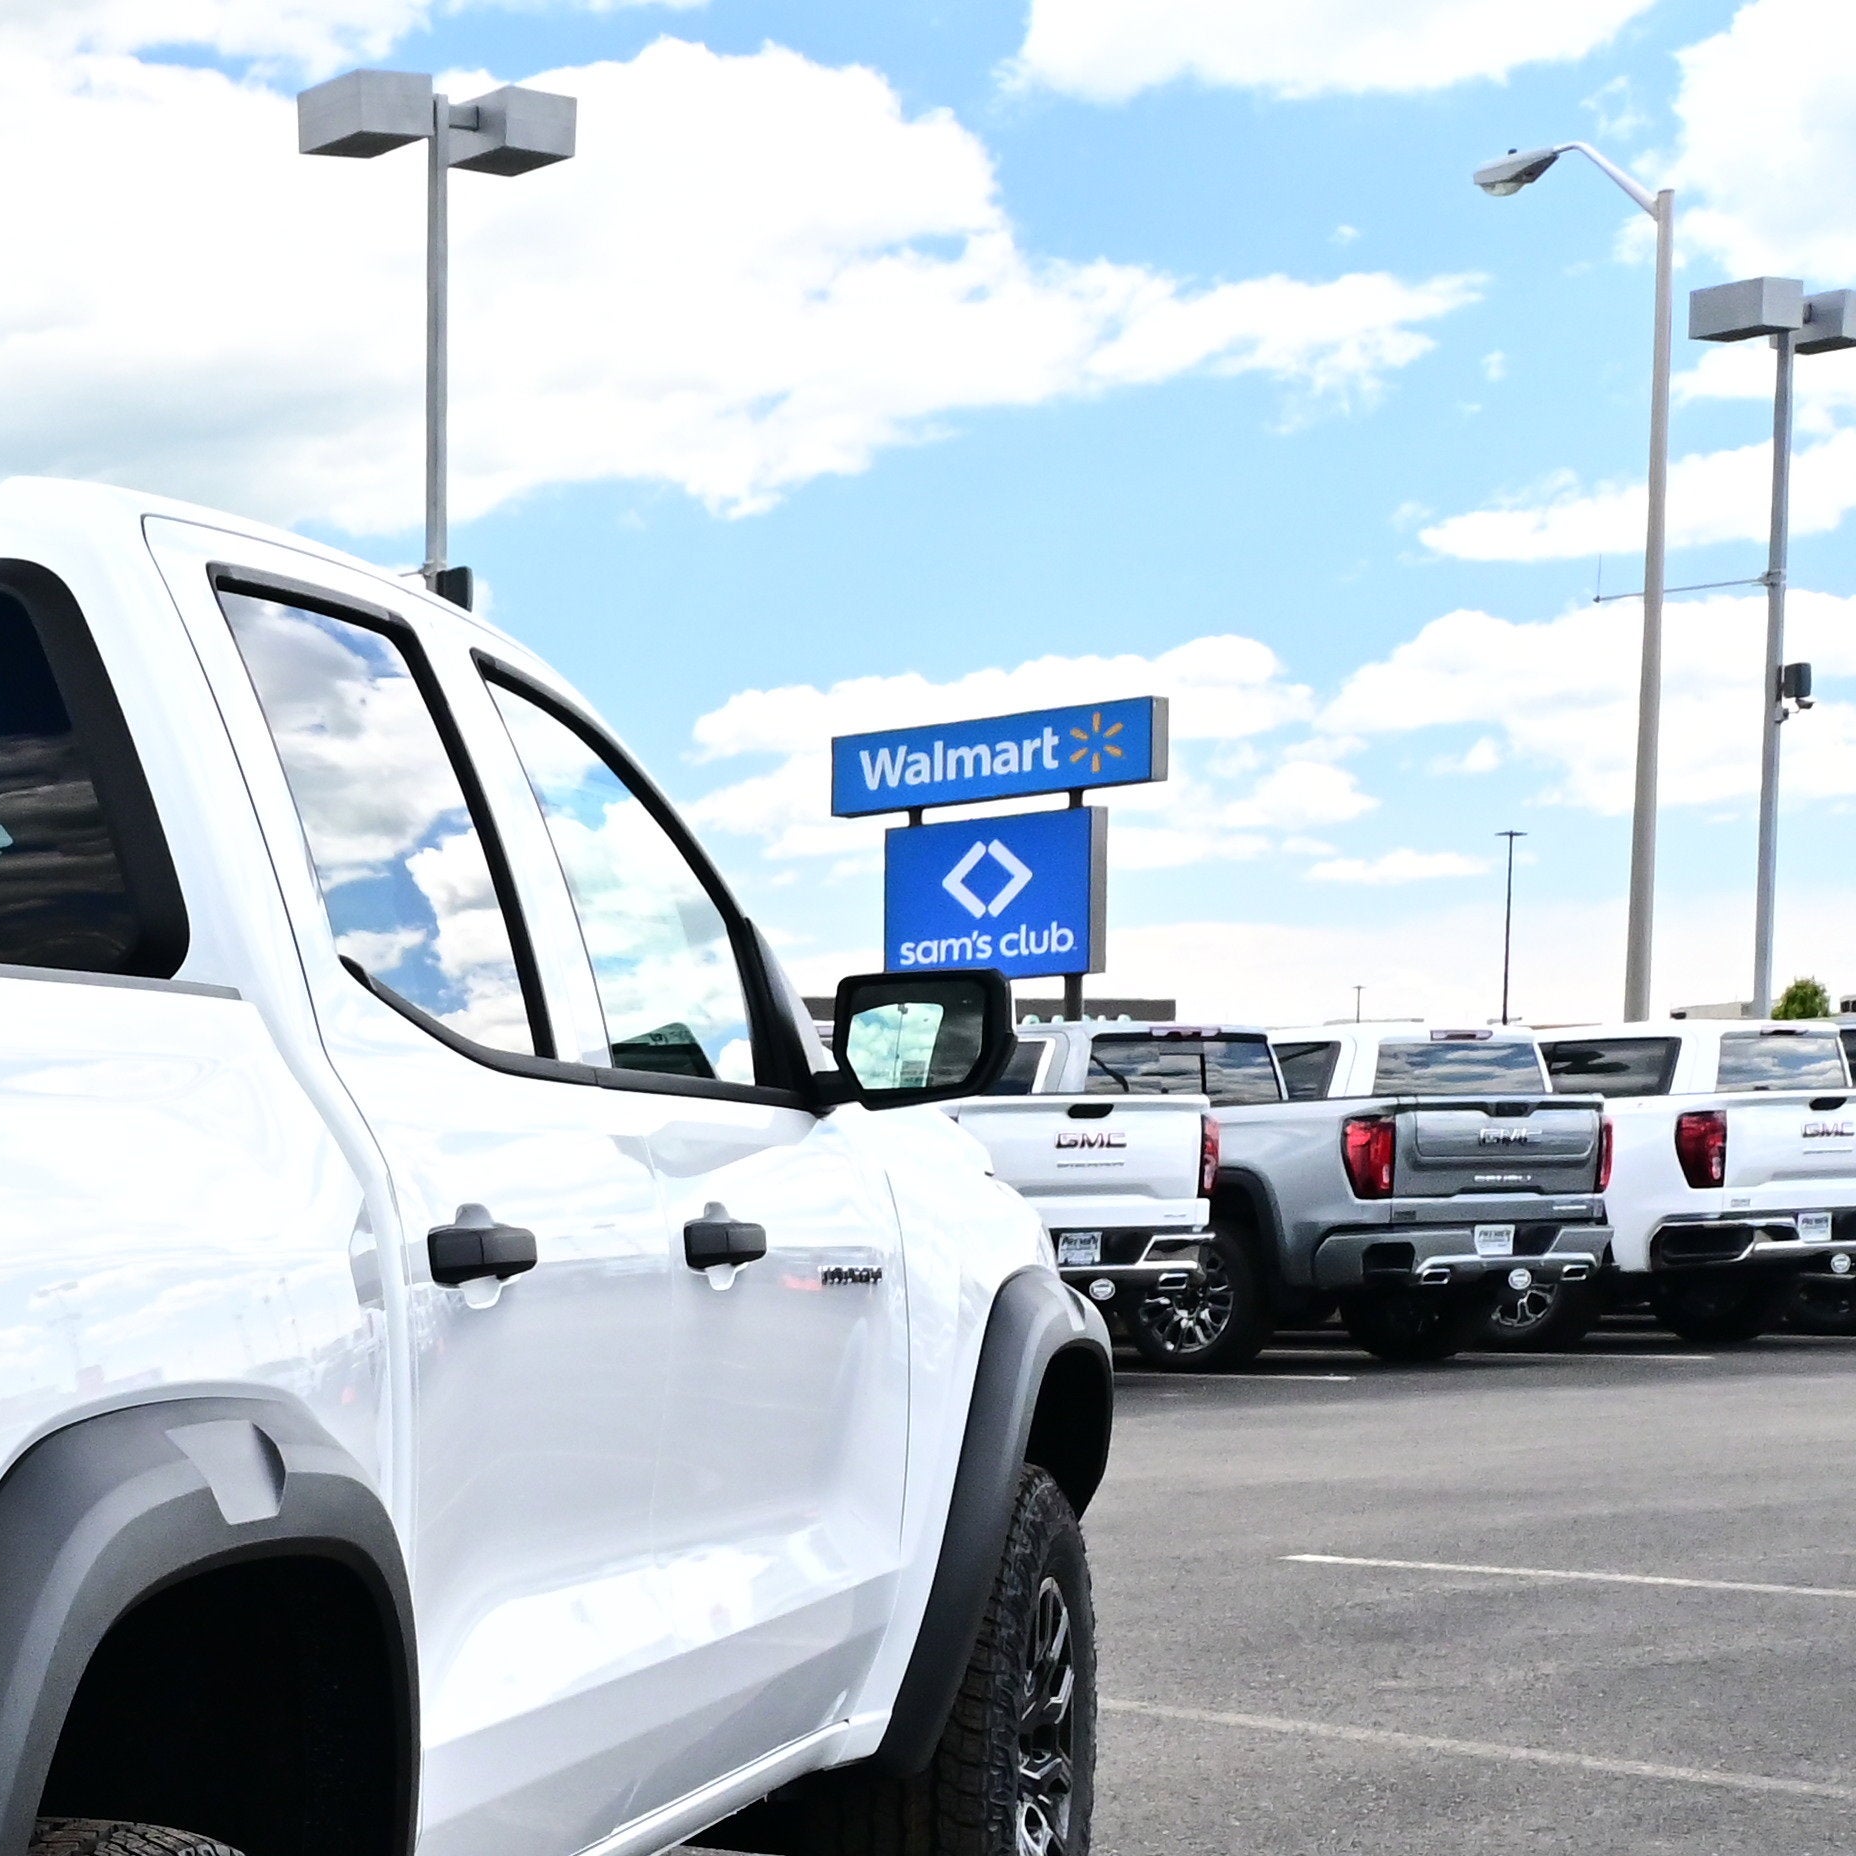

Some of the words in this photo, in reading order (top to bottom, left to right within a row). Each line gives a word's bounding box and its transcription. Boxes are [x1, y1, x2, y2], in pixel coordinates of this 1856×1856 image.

[859, 727, 1059, 790] Walmart
[900, 931, 993, 965] sam's
[1000, 922, 1075, 957] club
[1479, 1128, 1542, 1146] GMC
[1801, 1122, 1855, 1138] GMC
[1054, 1132, 1127, 1149] GMC
